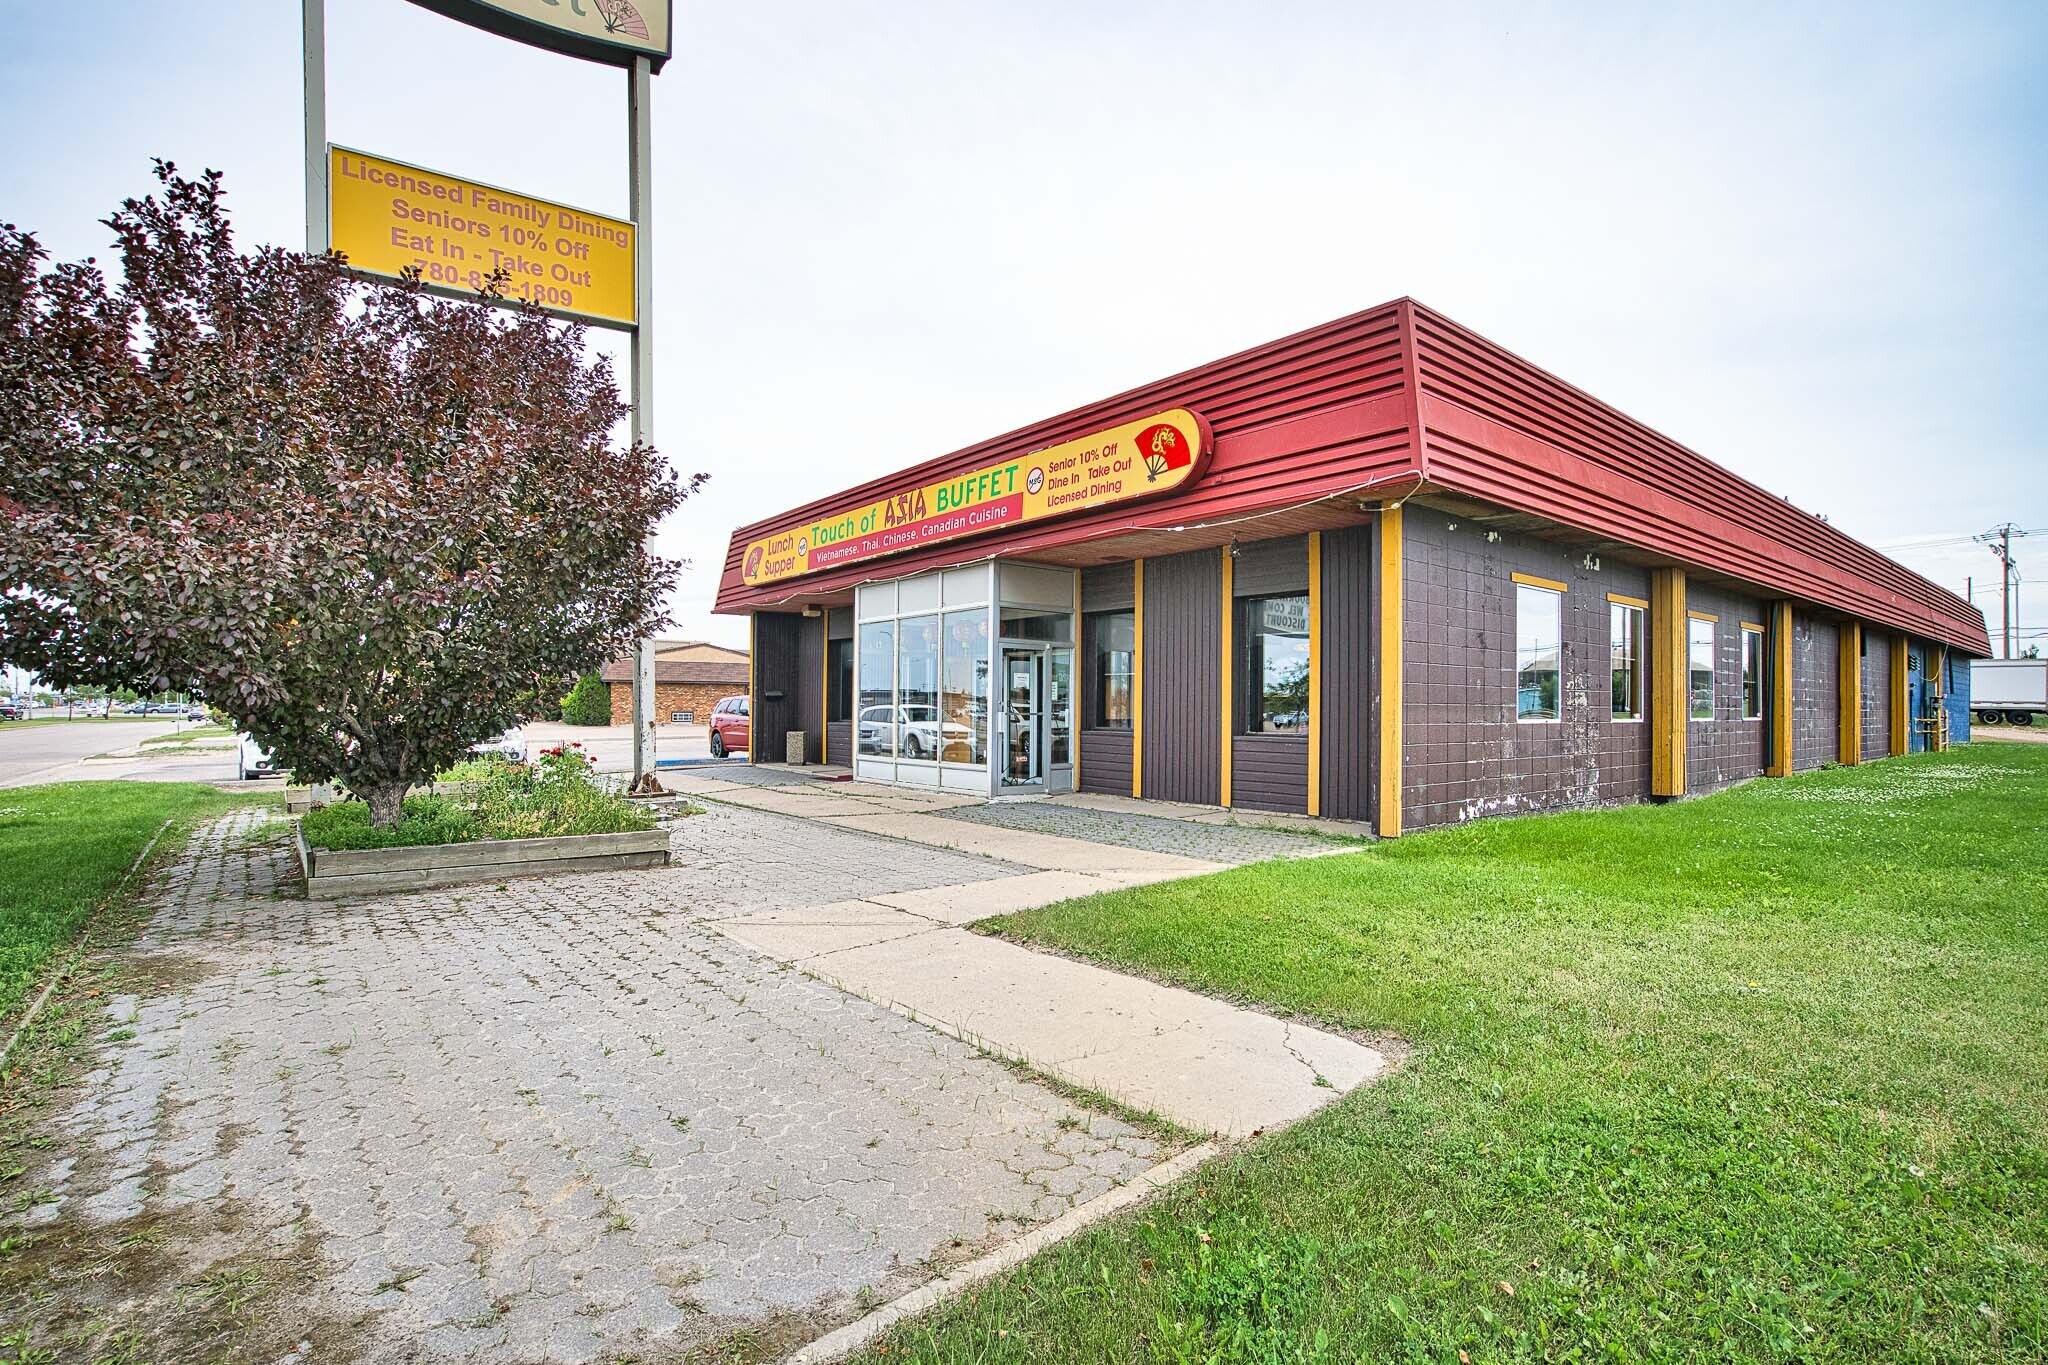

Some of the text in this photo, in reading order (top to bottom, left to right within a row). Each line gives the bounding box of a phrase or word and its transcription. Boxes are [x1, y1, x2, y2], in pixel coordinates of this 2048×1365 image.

[342, 156, 629, 248] Licensed Family Dining
[392, 198, 590, 261] Seniors 10% Off
[391, 226, 434, 254] Eat
[443, 238, 465, 260] In
[489, 248, 544, 277] Take
[551, 263, 591, 287] Out
[414, 258, 573, 307] 780-85-1809
[1048, 442, 1119, 474] Senior 10% Off
[1048, 457, 1132, 490] Dine In Take Out
[811, 464, 1019, 546] Touch of ASIA BUFFET
[1047, 479, 1122, 507] Licensed Dining
[921, 516, 966, 537] Canadian
[969, 505, 1008, 525] Cuisine
[764, 534, 796, 577] Lunch Supper
